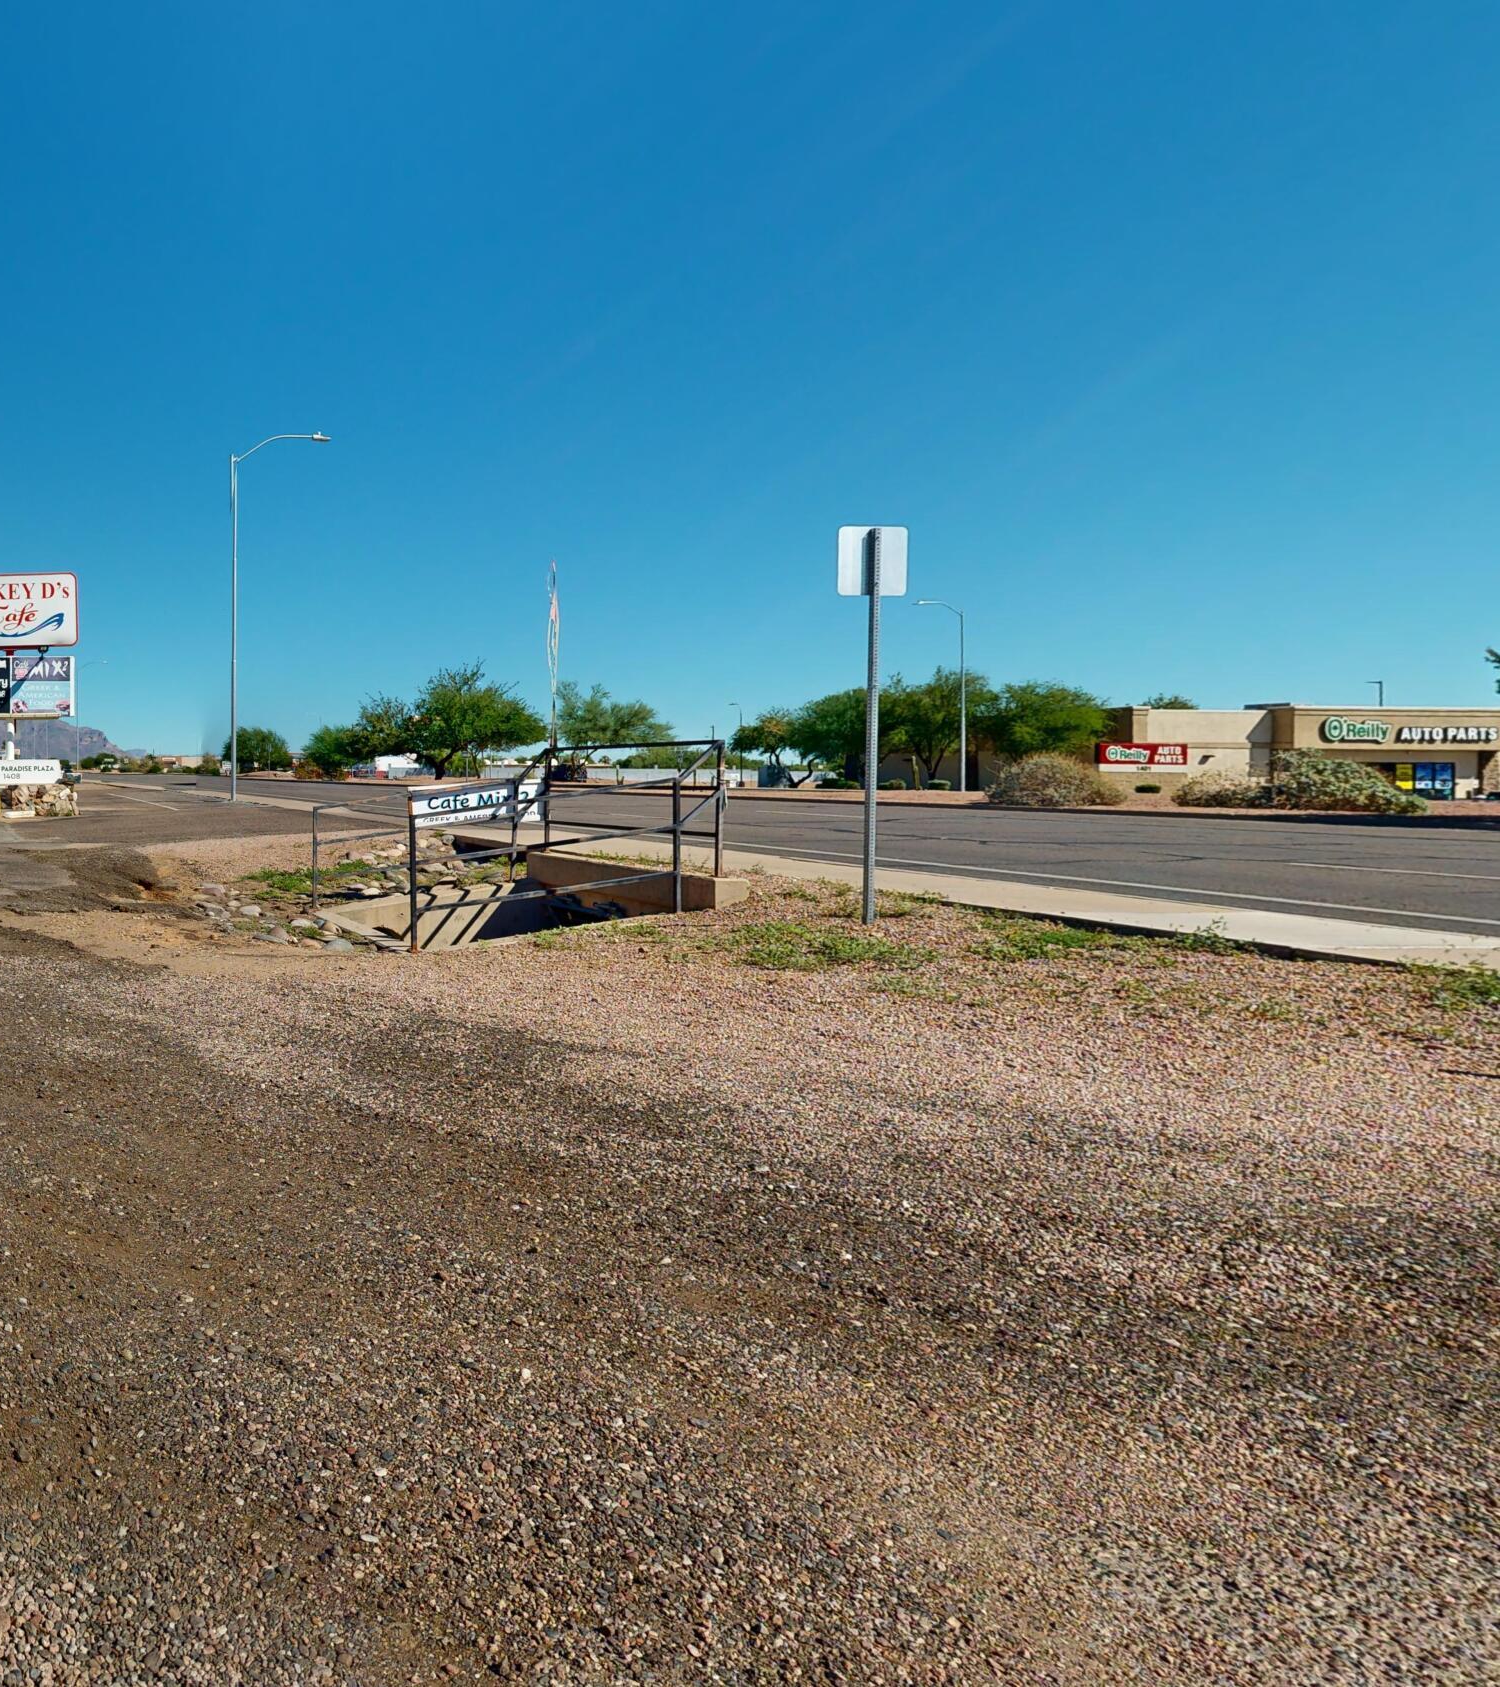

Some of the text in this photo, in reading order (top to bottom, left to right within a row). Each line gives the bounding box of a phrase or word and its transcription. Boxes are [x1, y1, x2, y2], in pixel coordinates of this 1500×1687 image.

[41, 582, 70, 599] D's
[1325, 716, 1498, 741] O'Reilly AUTO PARTS
[1106, 745, 1150, 763] O'Reilly
[1157, 746, 1182, 754] AUTO
[1154, 755, 1184, 763] PARTS
[427, 793, 470, 810] Café
